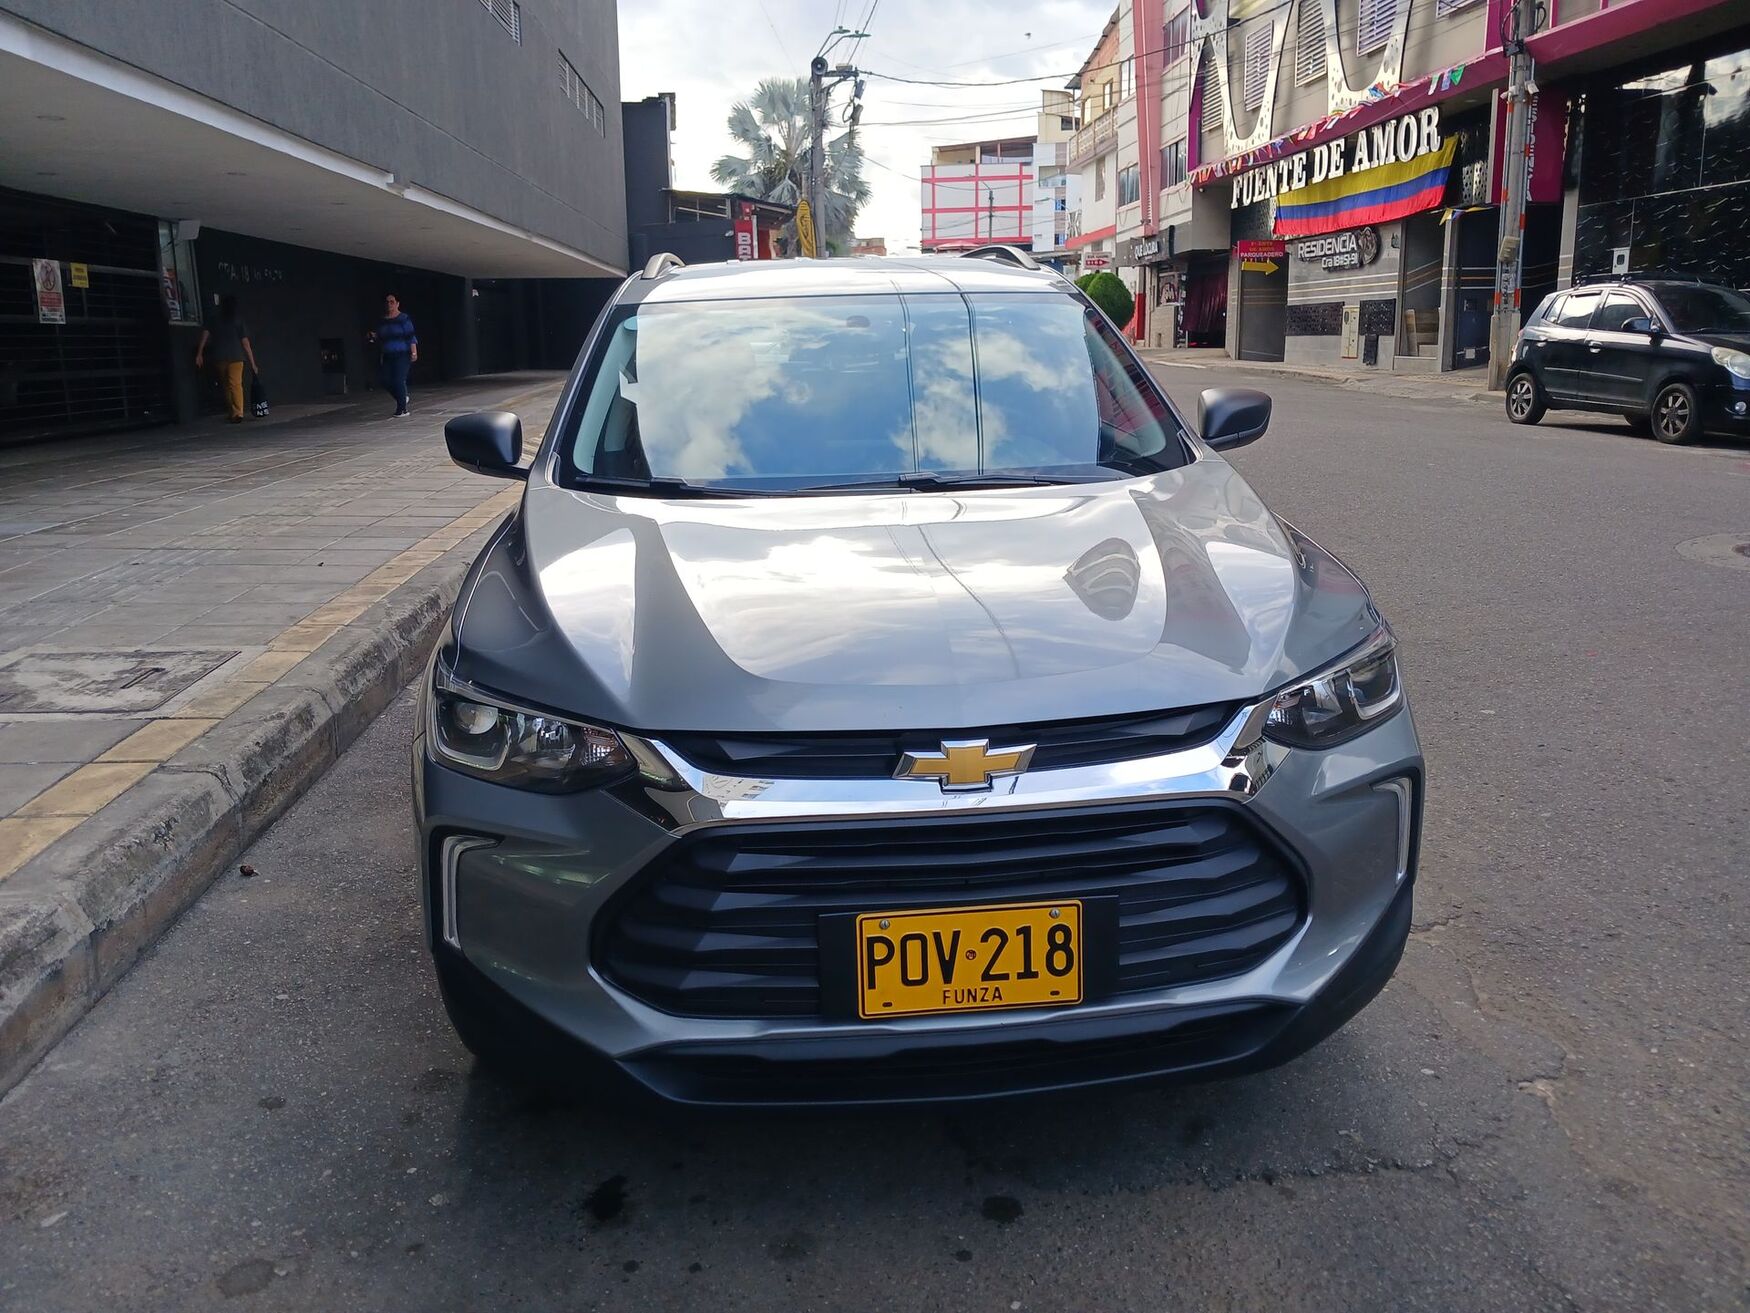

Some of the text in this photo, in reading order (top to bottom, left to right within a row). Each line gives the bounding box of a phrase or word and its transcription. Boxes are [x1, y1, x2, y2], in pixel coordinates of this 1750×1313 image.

[1230, 105, 1442, 210] FUENTE DE AMOR
[1298, 232, 1358, 259] RESIDENCIA
[1321, 257, 1333, 268] Cra
[866, 923, 1075, 990] POV 218
[942, 986, 1003, 1005] FUNZA
